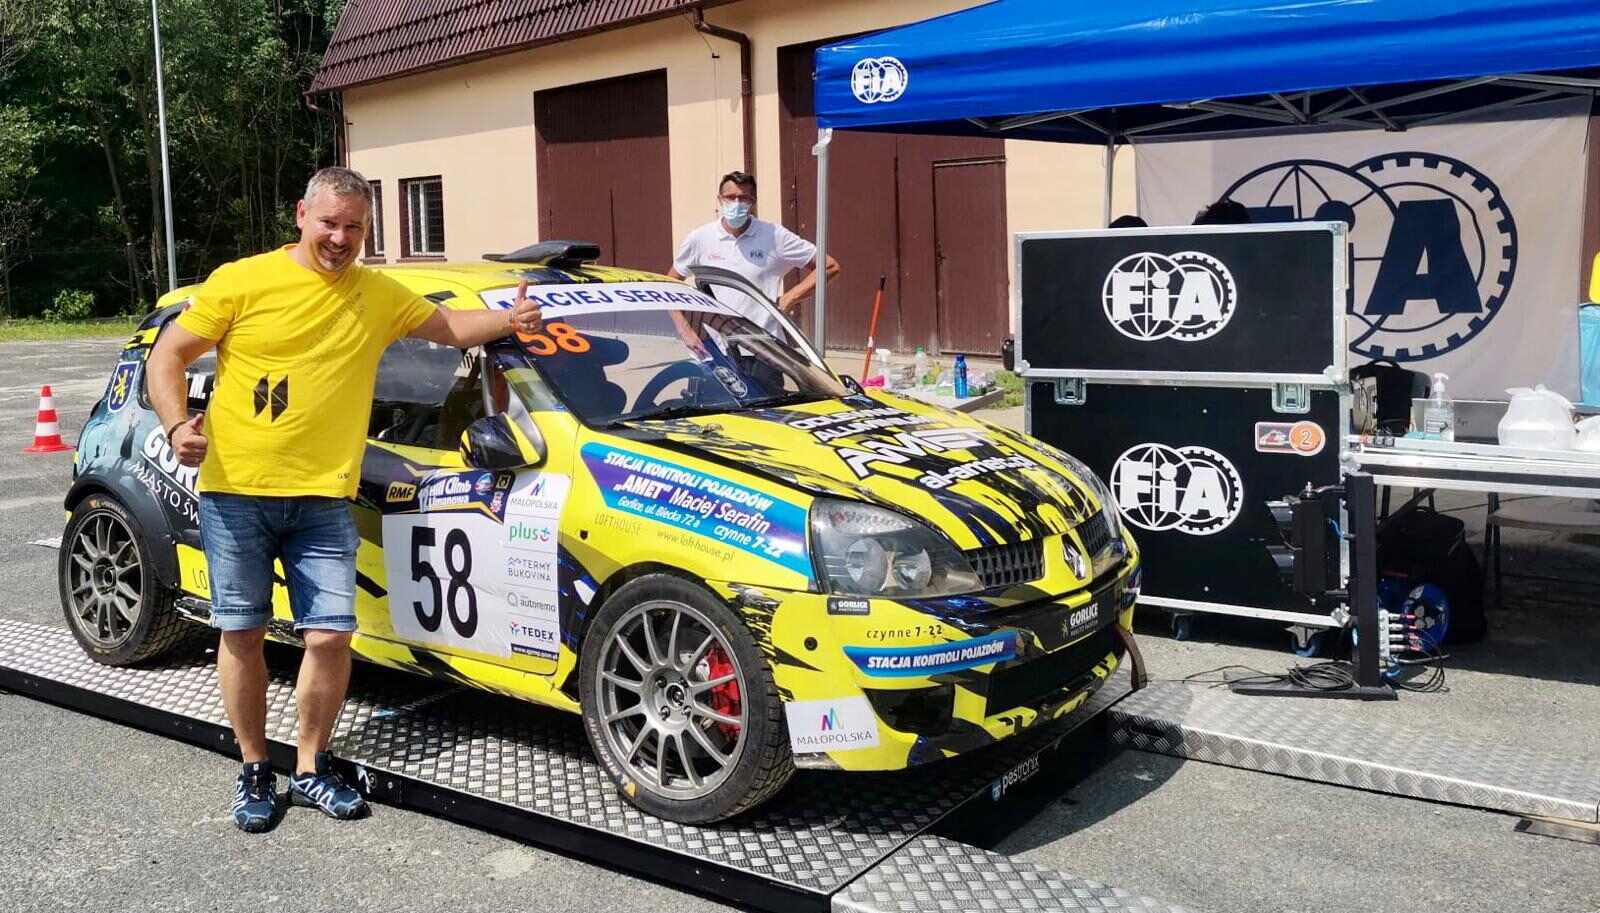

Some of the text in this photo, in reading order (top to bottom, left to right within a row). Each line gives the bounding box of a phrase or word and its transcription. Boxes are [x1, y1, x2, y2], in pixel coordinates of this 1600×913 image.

[614, 289, 719, 307] SERAFIN
[516, 321, 592, 357] 58
[1302, 430, 1312, 446] 2
[128, 461, 181, 508] MIASTO
[387, 485, 415, 499] RMF
[430, 475, 472, 496] Hill Climb
[603, 451, 774, 512] STACJA KONTROLI POJAZDÓW
[669, 487, 718, 520] Maciej
[714, 502, 771, 535] Serafin
[713, 524, 752, 545] czynne
[507, 567, 552, 582] BUKOVINA
[522, 559, 551, 571] TERMY
[411, 525, 478, 639] 58
[1070, 602, 1098, 627] GORLICE
[521, 626, 554, 641] TEDEX
[866, 628, 911, 641] czynne
[867, 639, 1005, 668] STACJA KONTROLI POJAZDÓW
